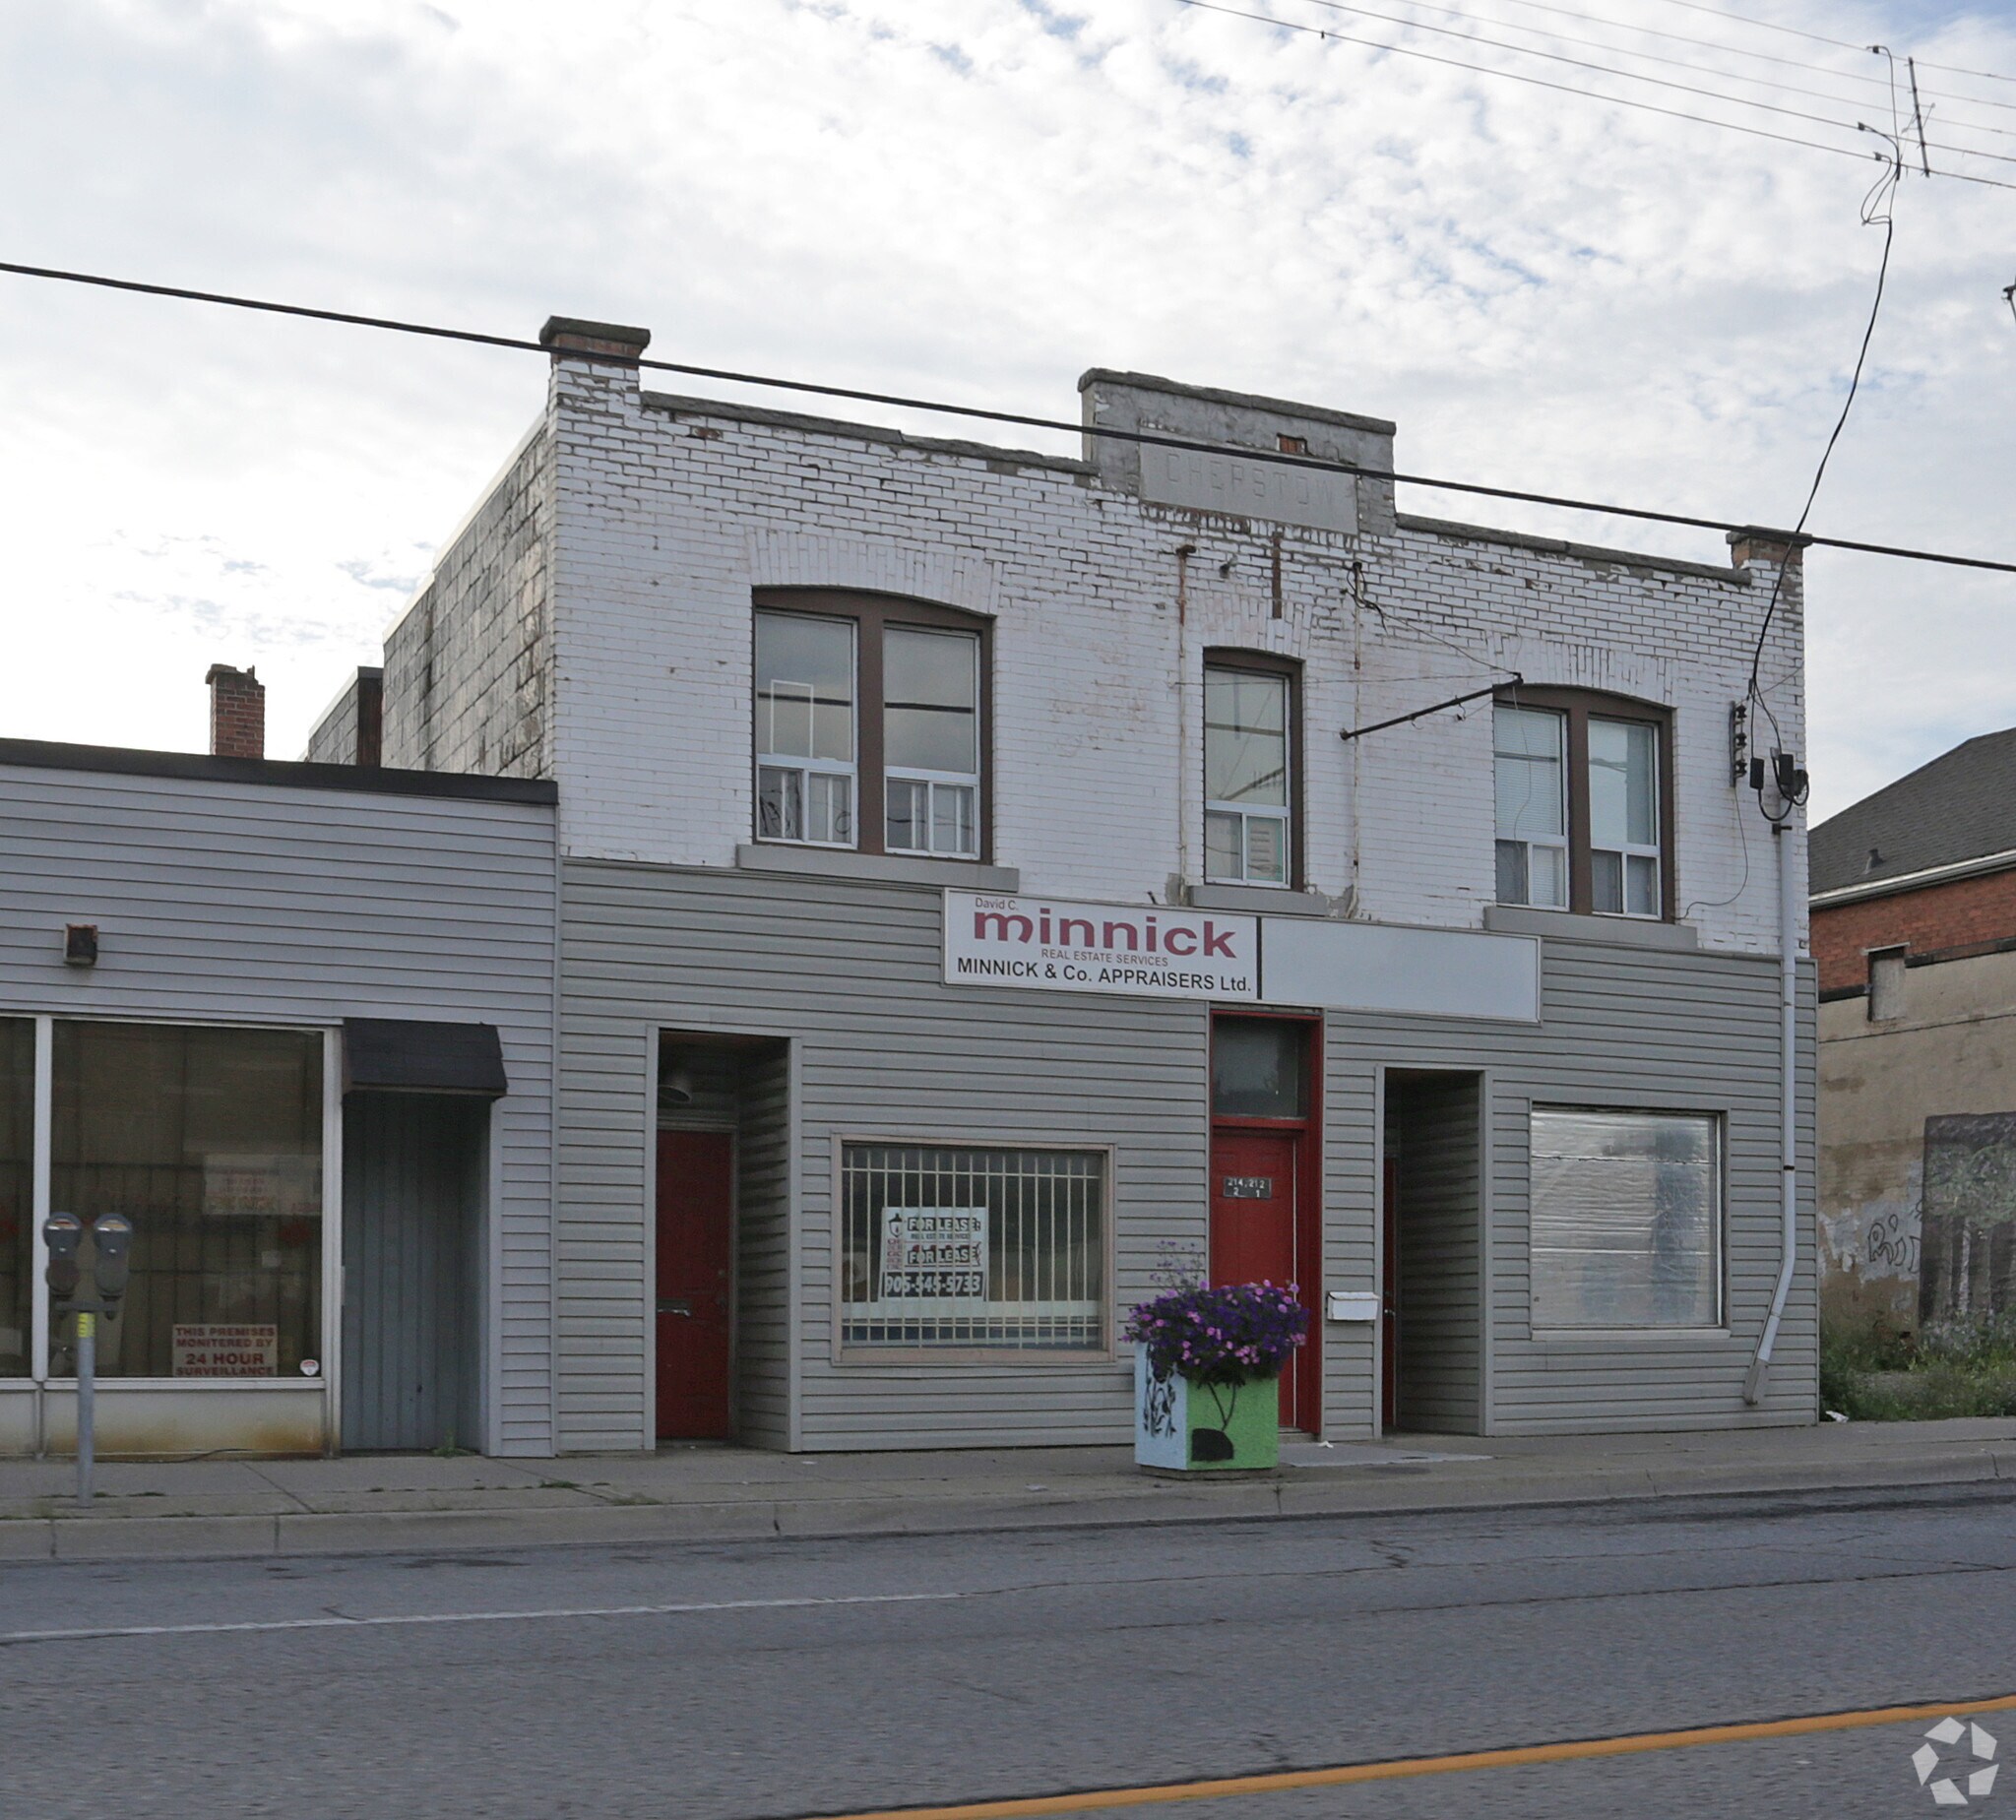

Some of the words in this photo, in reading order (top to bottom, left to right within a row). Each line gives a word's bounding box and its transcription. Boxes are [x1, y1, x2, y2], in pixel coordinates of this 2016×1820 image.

[975, 897, 1005, 910] David
[1007, 900, 1019, 910] C.
[974, 908, 1237, 959] minnick
[1041, 948, 1070, 960] REAL
[1073, 951, 1112, 964] ESTATE
[1116, 954, 1168, 967] SERVICES
[958, 957, 1039, 977] MINNICK
[1044, 964, 1057, 979] &
[1063, 965, 1092, 981] Co.
[1099, 968, 1215, 989] APPRAISERS
[1221, 975, 1251, 992] Ltd.
[908, 1218, 934, 1230] FOR
[937, 1219, 976, 1231] LEASE
[909, 1249, 935, 1264] FOR
[937, 1249, 976, 1263] LEASE
[175, 1327, 205, 1337] THIS
[209, 1327, 275, 1337] PREMISES
[256, 1339, 274, 1348] BY
[185, 1352, 207, 1365] 24
[213, 1352, 265, 1365] HOUR
[175, 1366, 274, 1376] SURVEILLANCE
